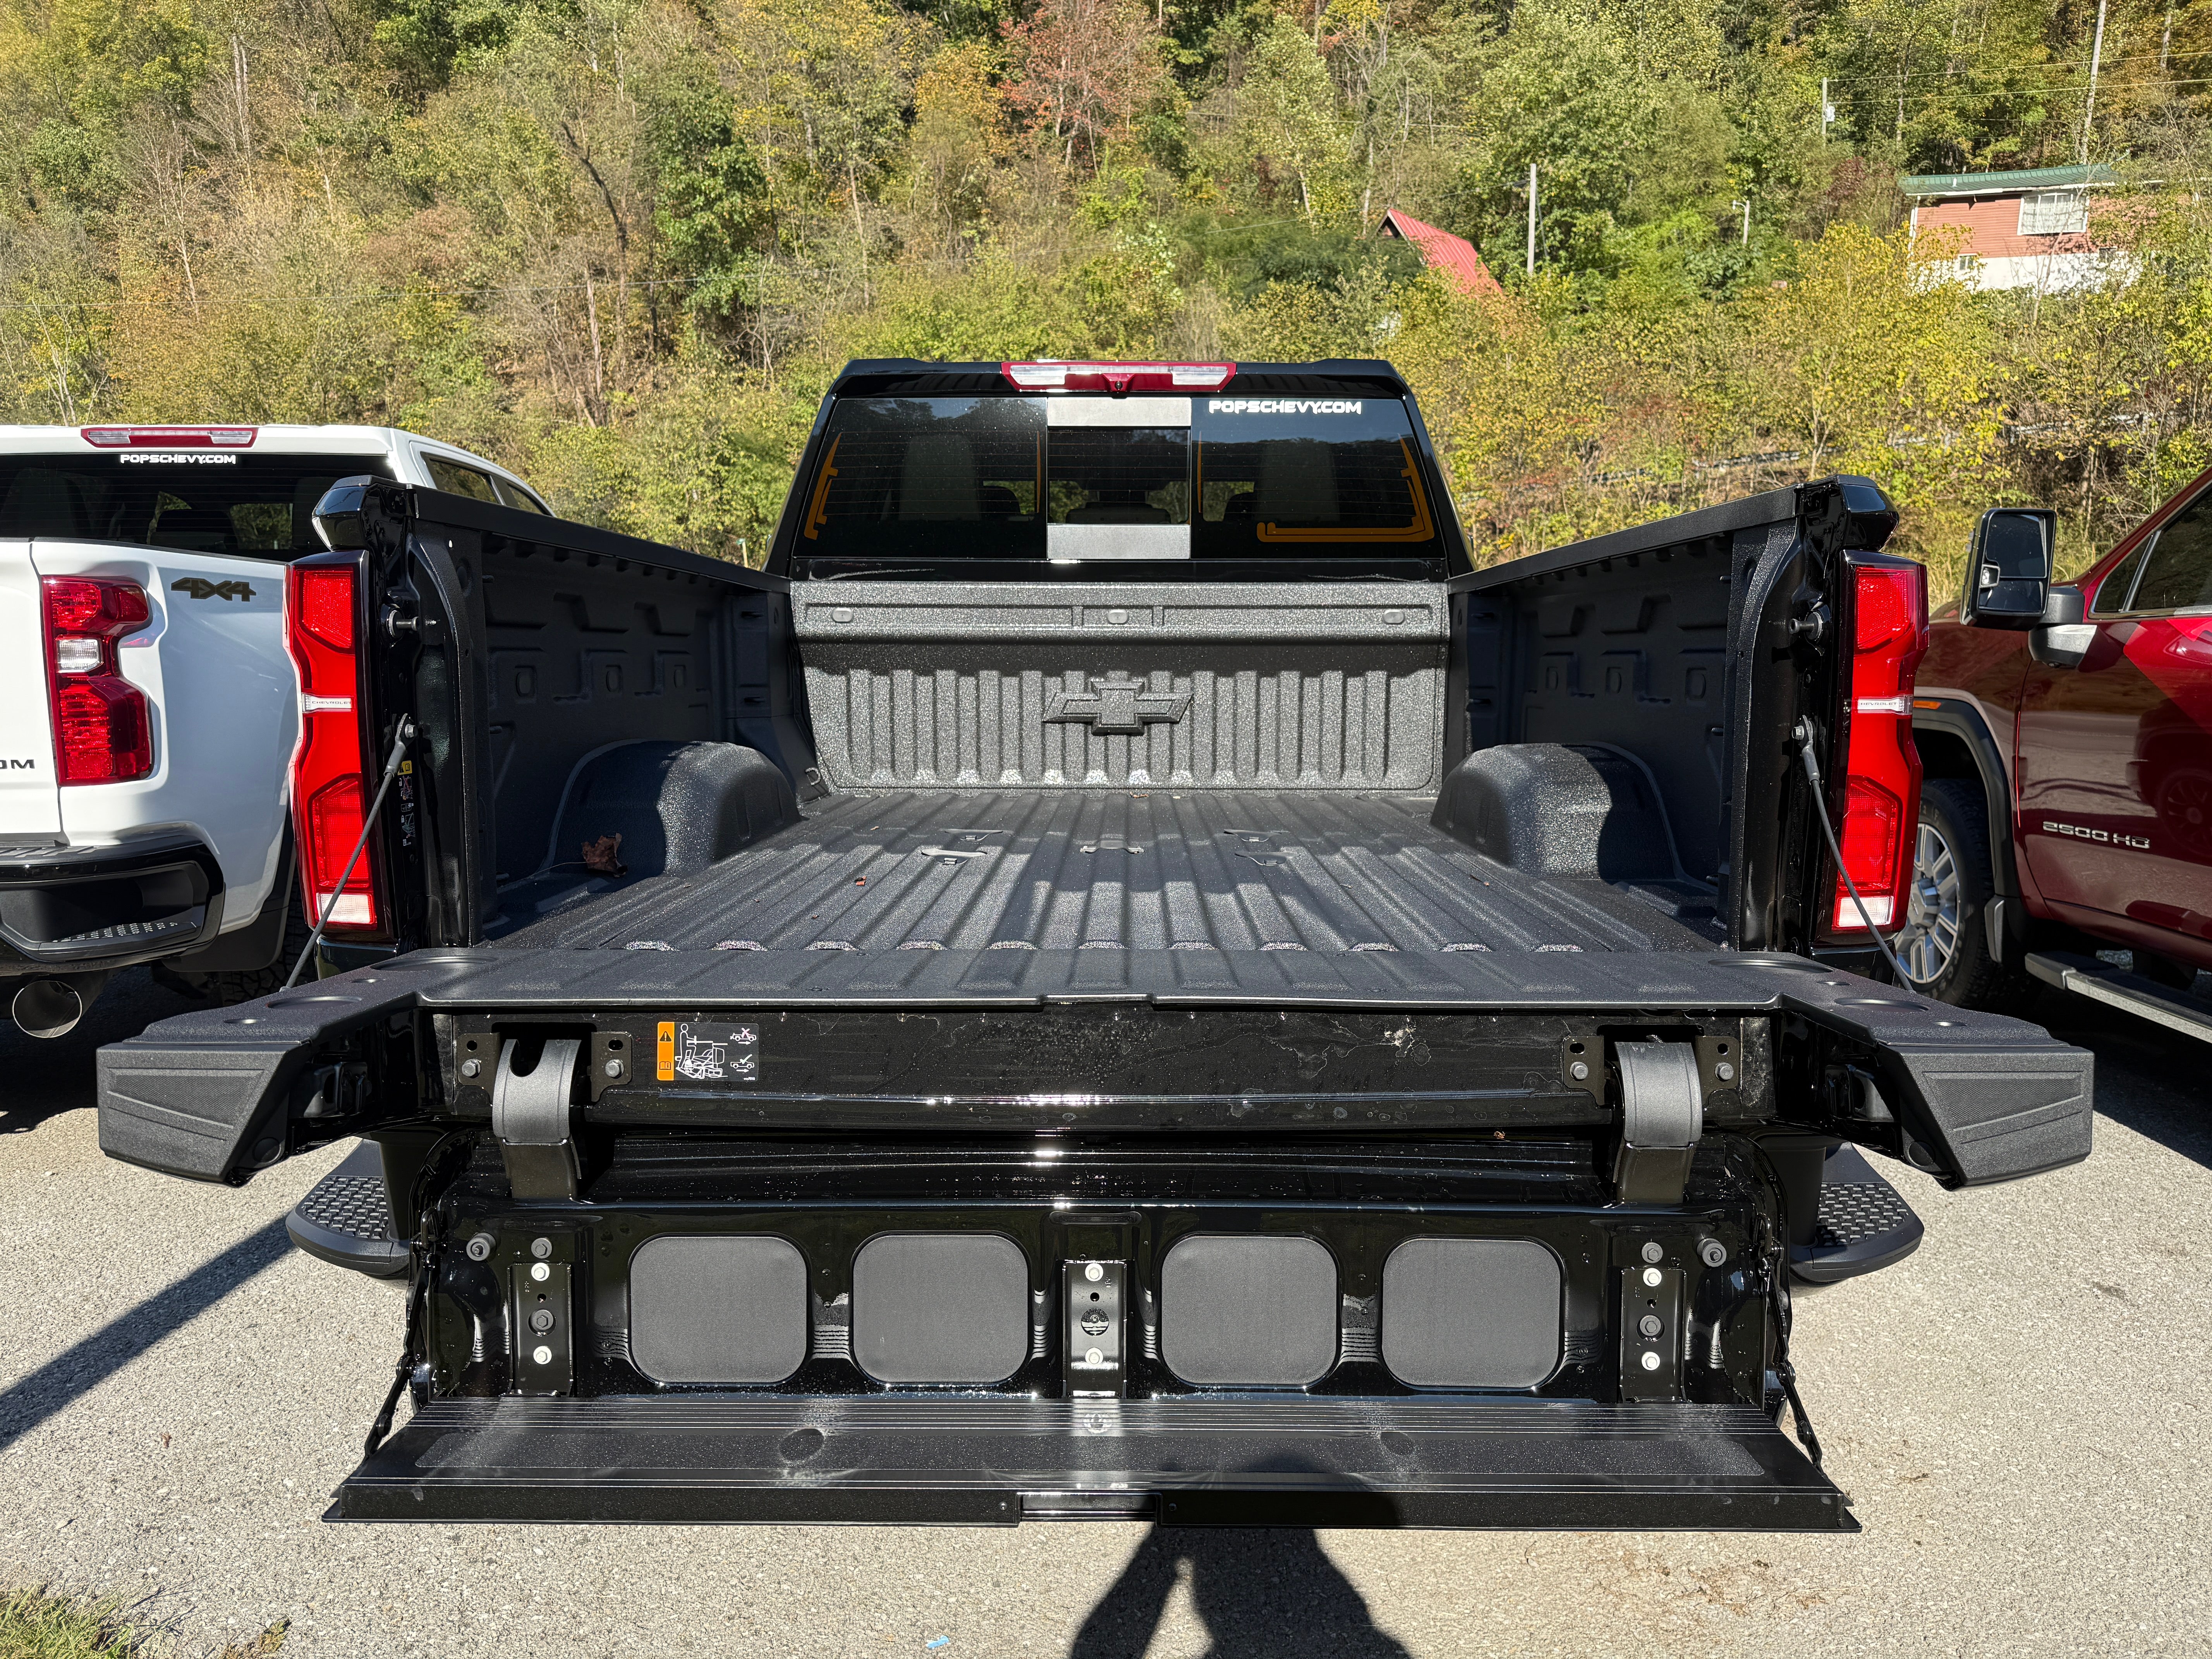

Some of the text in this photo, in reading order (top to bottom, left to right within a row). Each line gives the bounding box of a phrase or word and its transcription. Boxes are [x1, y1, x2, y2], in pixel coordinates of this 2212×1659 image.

[1209, 400, 1362, 415] POPSCHEVY.COM
[120, 454, 236, 464] POPSCHEVY.COM
[2043, 821, 2150, 849] 2500 HD
